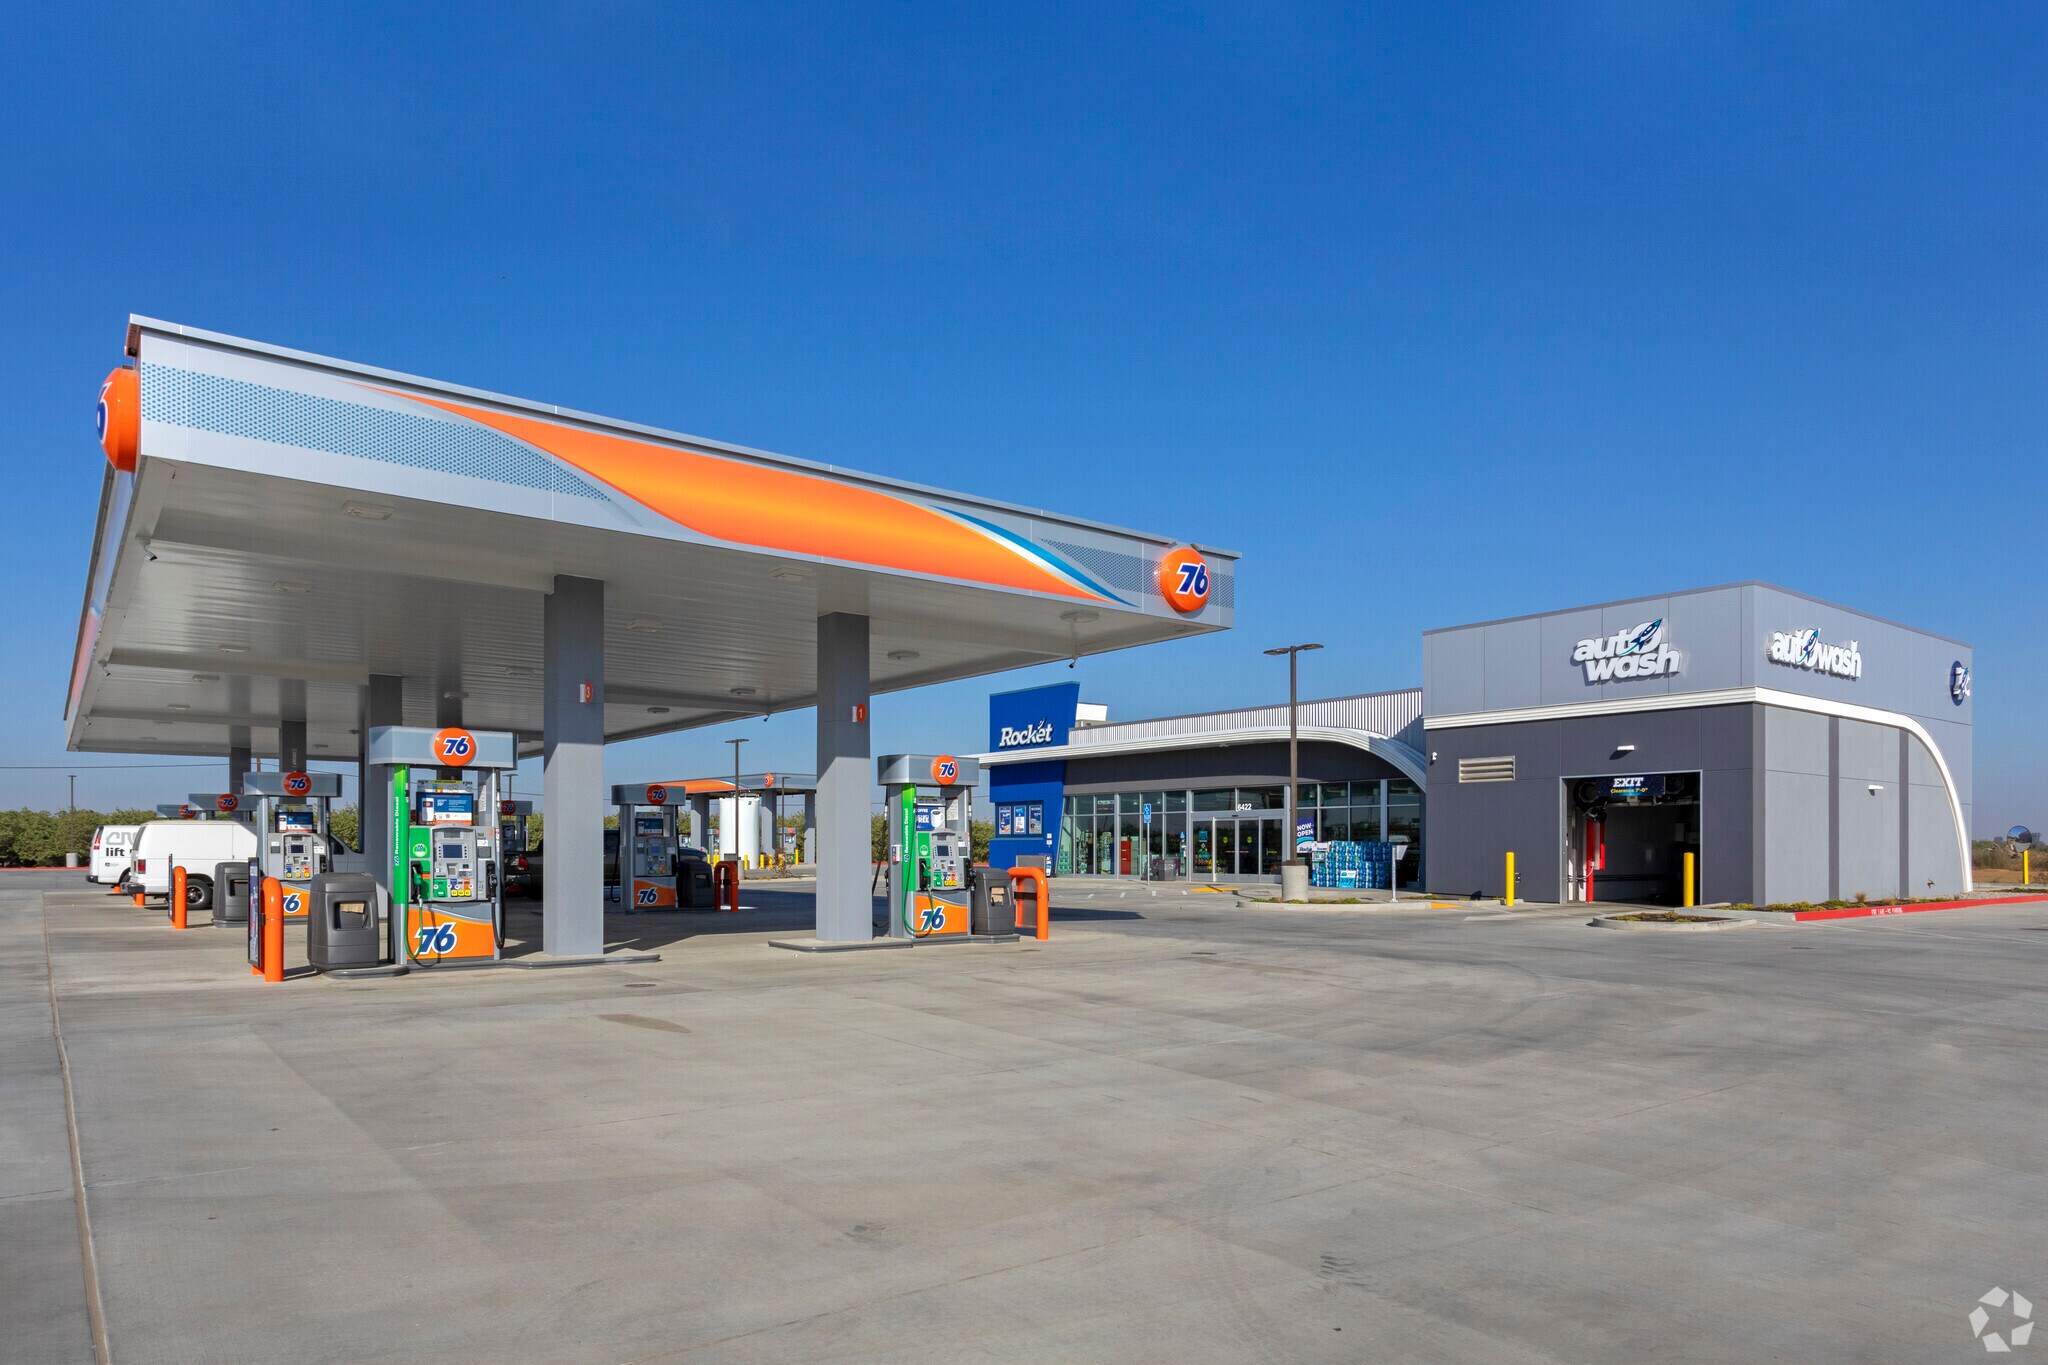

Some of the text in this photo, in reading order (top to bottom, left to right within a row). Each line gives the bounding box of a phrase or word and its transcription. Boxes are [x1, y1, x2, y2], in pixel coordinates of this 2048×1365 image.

[1175, 562, 1209, 598] 76
[1573, 619, 1662, 661] auto
[1585, 642, 1680, 683] wash
[999, 720, 1053, 747] Rocket
[443, 736, 470, 757] 76
[938, 761, 956, 778] 76
[289, 777, 308, 791] 76
[1613, 777, 1644, 788] EXIT
[221, 796, 235, 806] 76
[651, 789, 665, 800] 76
[1237, 803, 1252, 811] 6422
[1297, 823, 1311, 831] NOW
[1297, 829, 1313, 837] OPEN
[106, 847, 125, 857] lift
[282, 893, 302, 914] 6
[638, 886, 658, 905] 76
[919, 905, 946, 931] 76
[414, 922, 457, 956] 76
